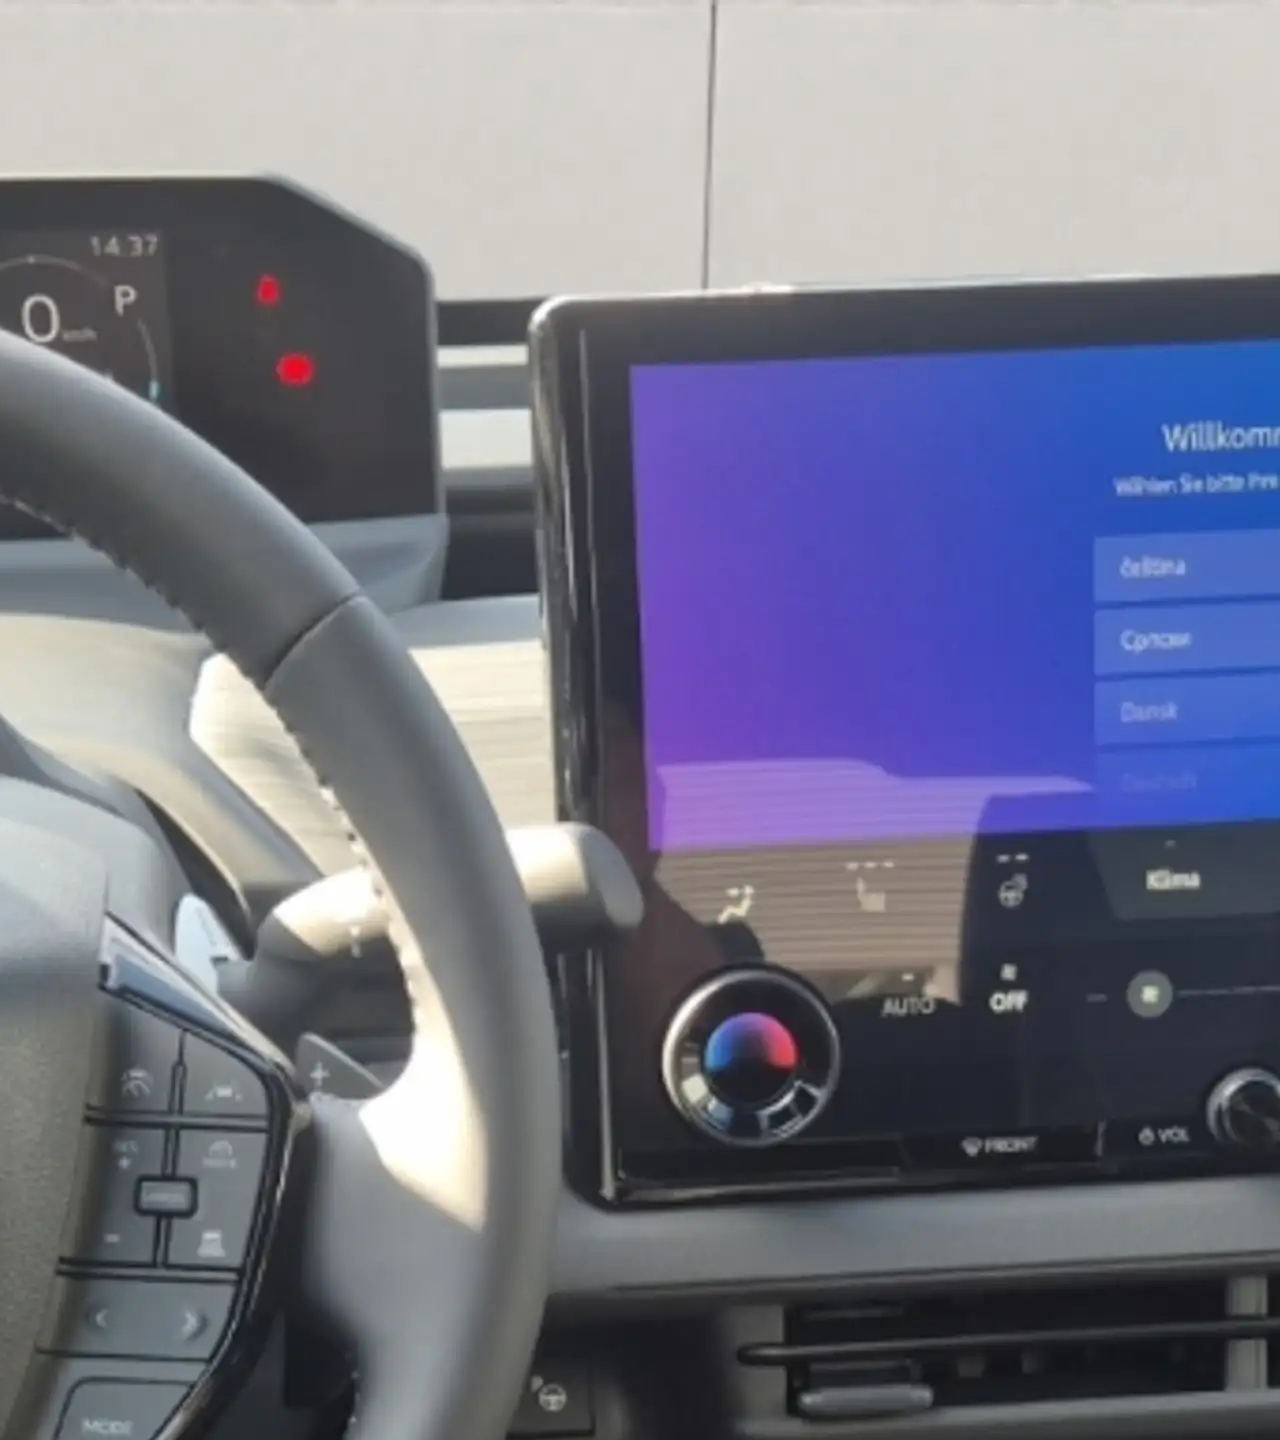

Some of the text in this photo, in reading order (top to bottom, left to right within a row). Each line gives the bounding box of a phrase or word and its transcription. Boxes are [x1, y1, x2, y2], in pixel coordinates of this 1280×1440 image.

[113, 283, 138, 316] P
[1179, 471, 1203, 494] Sie
[1205, 470, 1245, 493] bitte
[881, 996, 937, 1018] AUTO
[988, 989, 1029, 1015] OFF
[1157, 1124, 1191, 1144] VOL
